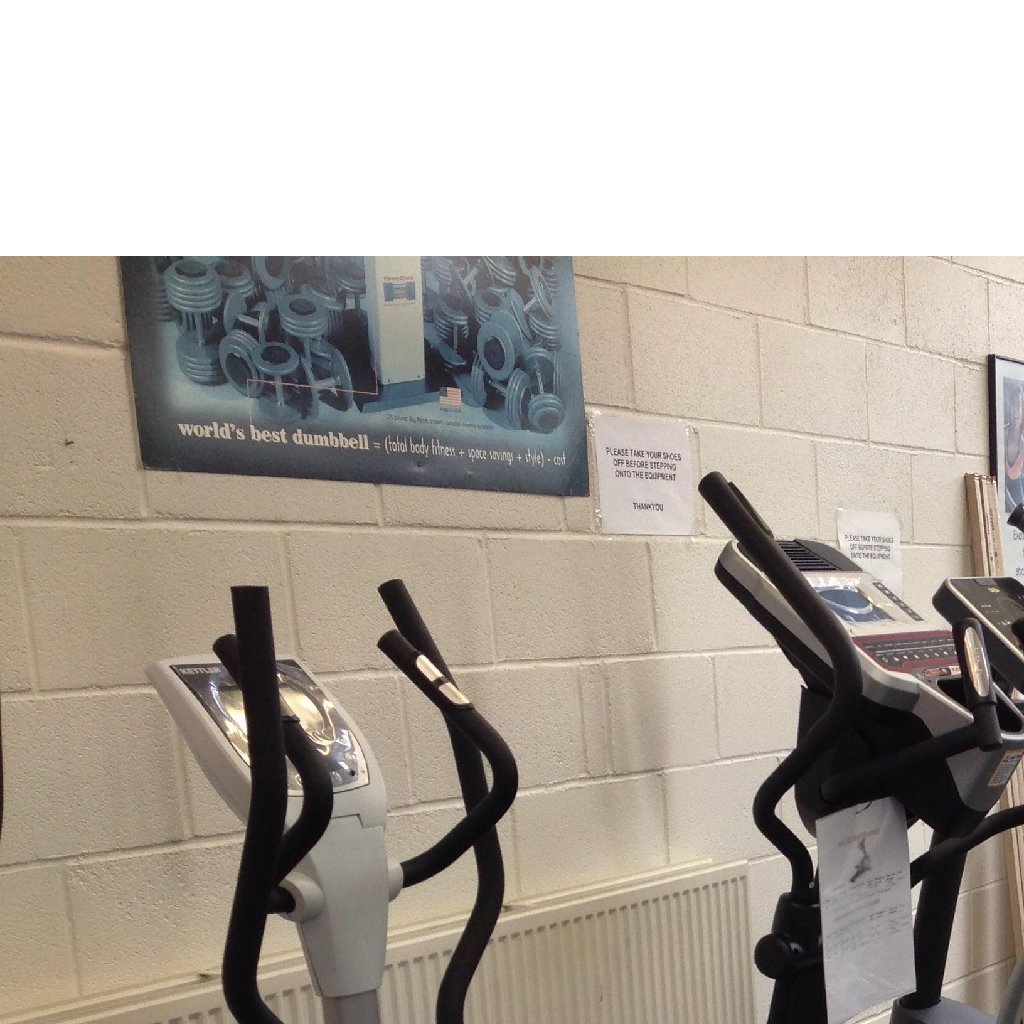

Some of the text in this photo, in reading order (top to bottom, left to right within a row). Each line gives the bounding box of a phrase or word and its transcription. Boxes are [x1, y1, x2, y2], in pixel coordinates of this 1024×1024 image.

[177, 422, 246, 441] world's
[250, 425, 288, 444] best
[292, 429, 370, 450] dumbbell
[384, 435, 408, 455] (total
[410, 437, 429, 457] body
[431, 439, 456, 457] fitness
[468, 448, 487, 462] space
[489, 449, 514, 465] savings
[553, 452, 566, 466] cost
[606, 447, 682, 461] PLEASE TAKE YOUR SHOES
[613, 459, 677, 471] OFF BEFORE STEPPING
[615, 470, 677, 481] ONTO THE EQUIPMENT
